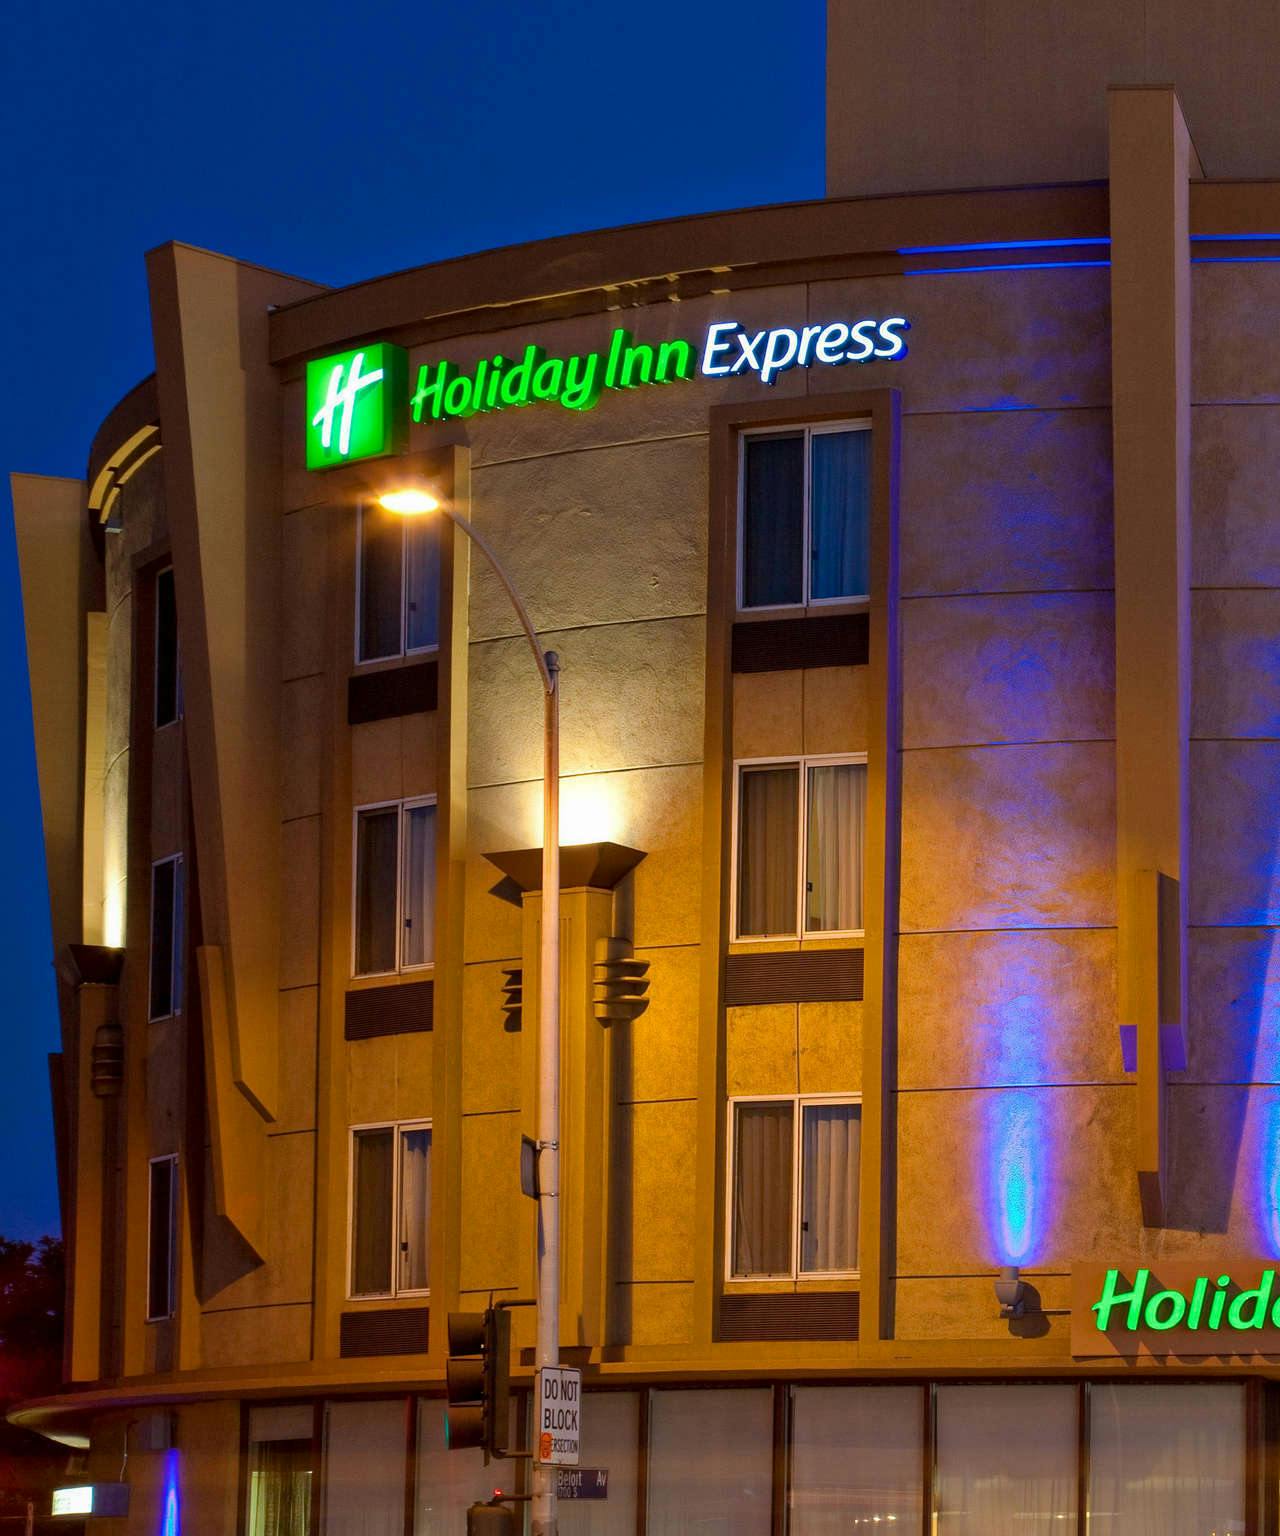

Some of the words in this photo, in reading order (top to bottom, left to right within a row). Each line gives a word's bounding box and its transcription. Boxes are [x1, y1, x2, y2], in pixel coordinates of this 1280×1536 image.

[410, 344, 598, 423] Holiday
[605, 328, 690, 388] Inn
[701, 317, 906, 383] Express
[544, 1378, 559, 1400] DO
[560, 1379, 579, 1402] NOT
[544, 1408, 579, 1431] BLOCK
[546, 1438, 578, 1454] ERSECTION
[596, 1470, 607, 1487] Av
